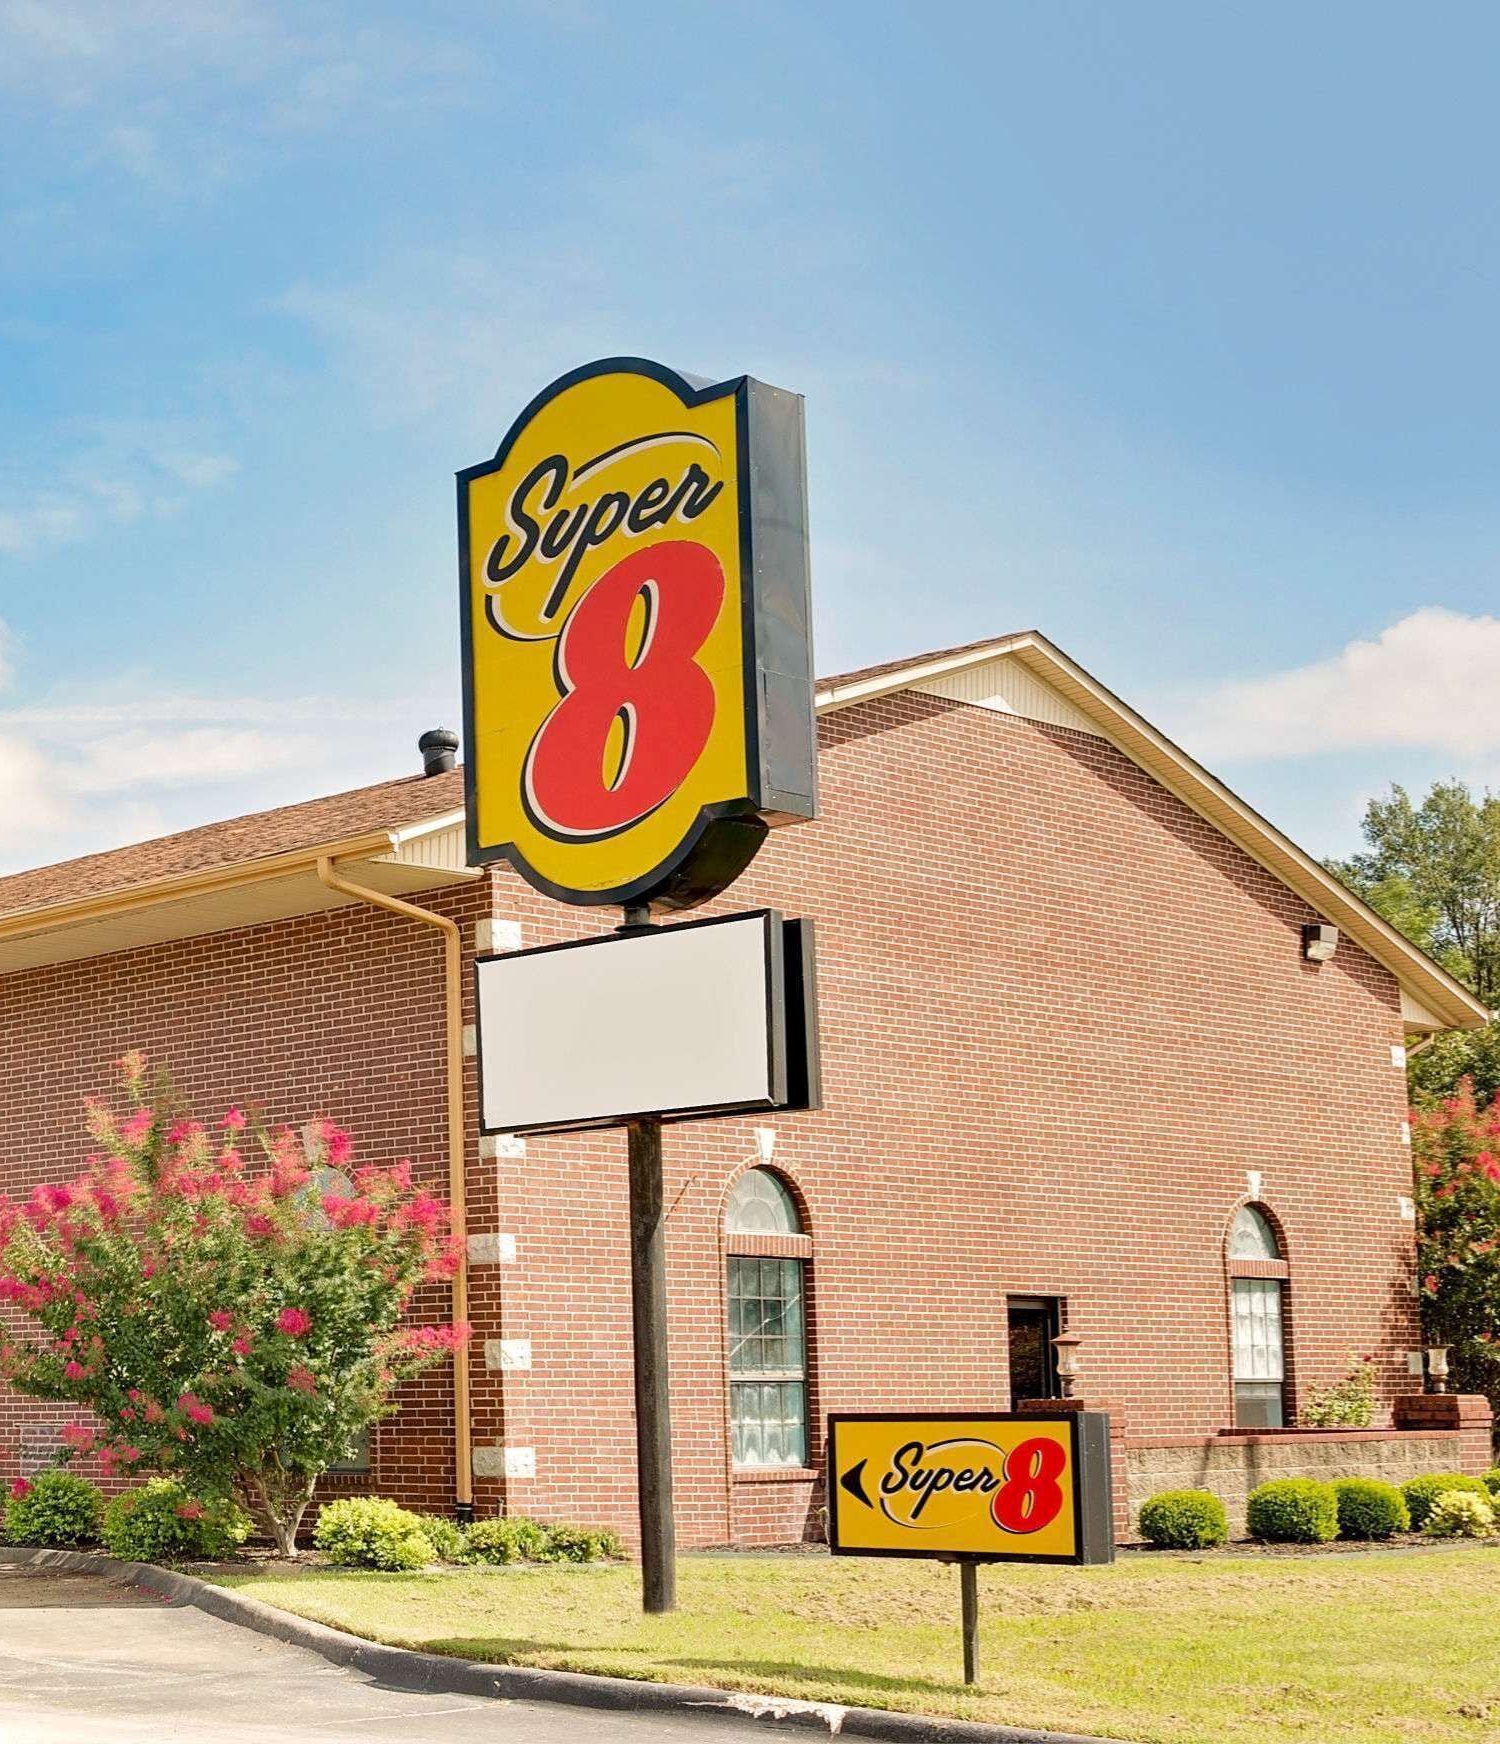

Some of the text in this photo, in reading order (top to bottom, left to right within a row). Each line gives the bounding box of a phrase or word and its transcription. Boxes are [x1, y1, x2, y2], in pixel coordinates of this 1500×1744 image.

[483, 454, 724, 622] Super
[520, 540, 725, 844] 8
[880, 1437, 1066, 1534] Super 8
